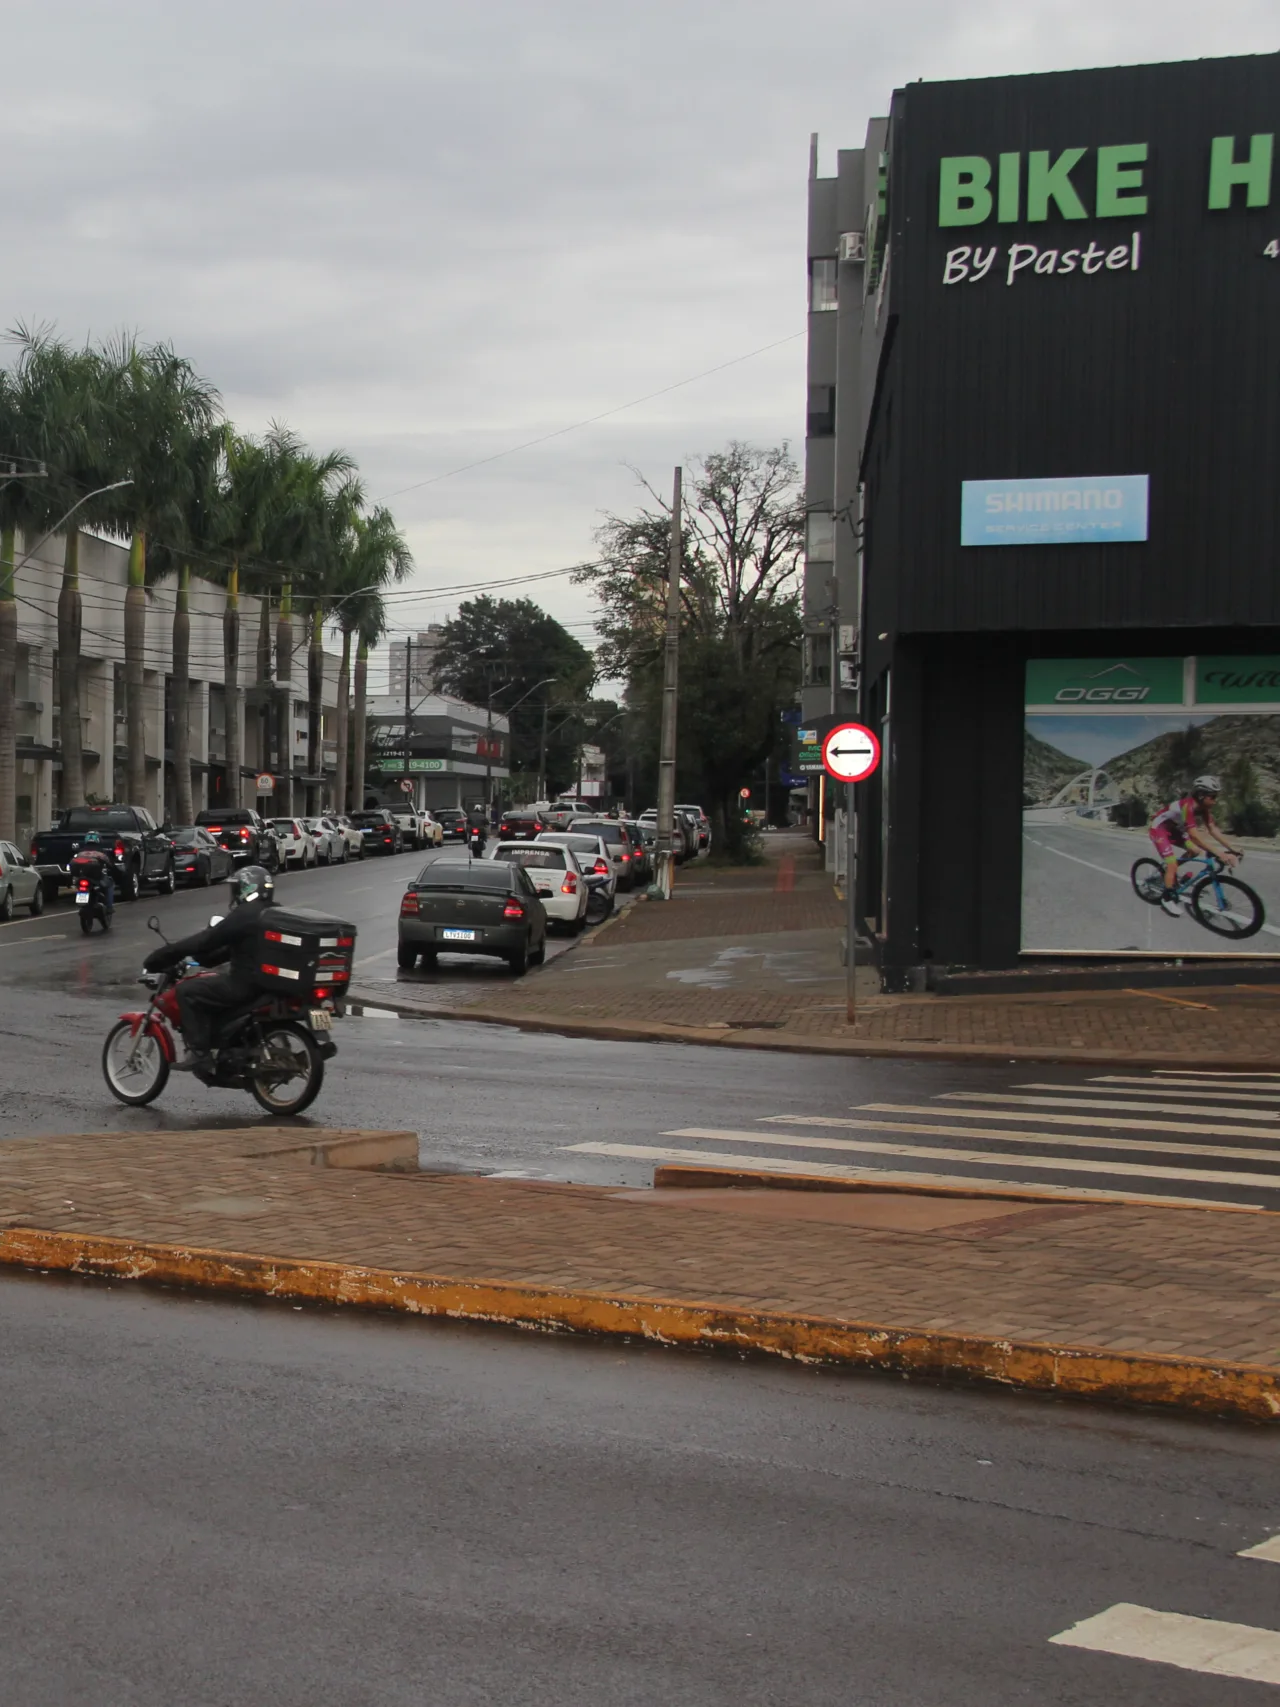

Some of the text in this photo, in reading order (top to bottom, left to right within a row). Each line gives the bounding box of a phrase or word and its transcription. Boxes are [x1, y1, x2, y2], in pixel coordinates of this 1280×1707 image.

[938, 143, 1148, 227] BIKE
[943, 231, 1141, 286] By Pastel
[985, 489, 1124, 513] SHIMANO
[985, 521, 1123, 533] SERVICE CENTER
[1055, 687, 1151, 701] OGGI
